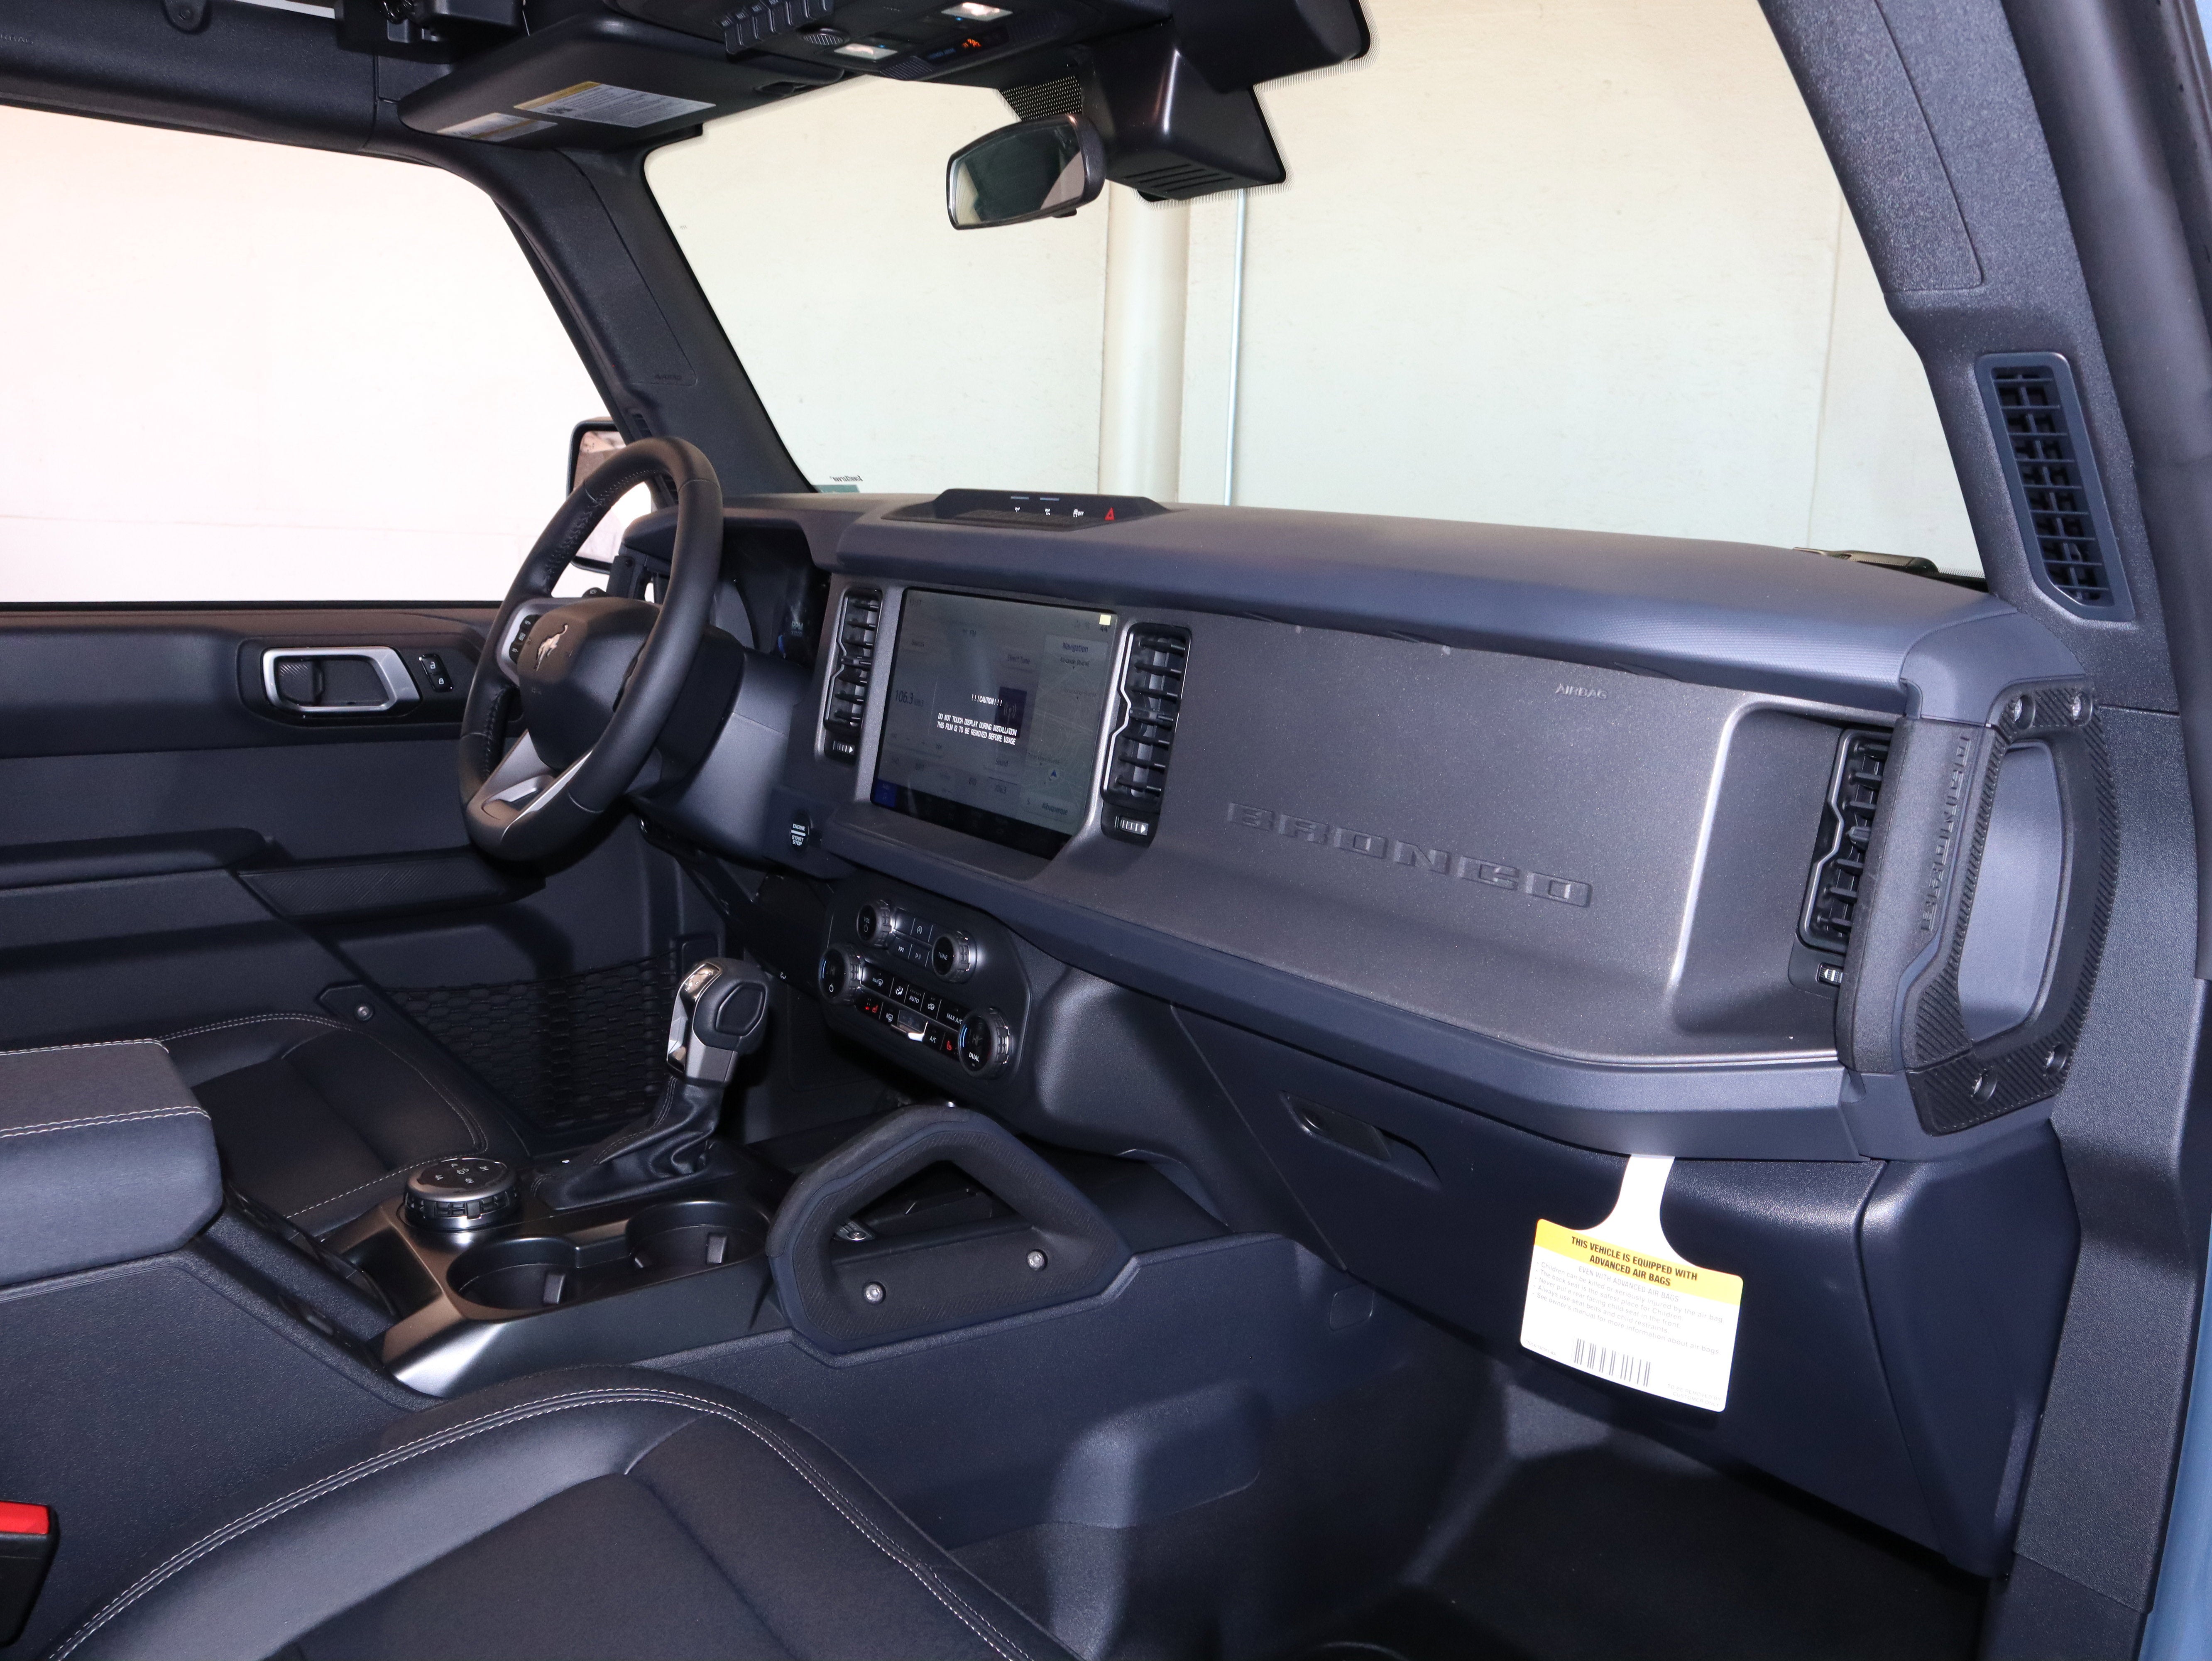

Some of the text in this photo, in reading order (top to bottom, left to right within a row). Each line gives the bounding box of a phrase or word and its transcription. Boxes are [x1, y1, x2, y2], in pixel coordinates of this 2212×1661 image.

[1063, 642, 1088, 653] Navigation
[896, 690, 913, 705] 106.3
[1555, 683, 1608, 699] AIRBAG
[952, 715, 964, 725] TOUCH
[964, 718, 979, 728] DISPLAY
[979, 721, 992, 731] DURING
[993, 725, 1017, 736] INSTALLATION
[971, 729, 987, 739] REMOVED
[988, 733, 1003, 742] BEFORE
[1003, 736, 1016, 745] USAGE
[1227, 802, 1593, 909] BRONCO
[938, 951, 948, 960] TUNE
[909, 995, 920, 1004] AUTO
[946, 1013, 956, 1022] MAX
[969, 1052, 980, 1062] DUAL
[1572, 1236, 1698, 1281] THIS VEHICLE IS EQUIPPED WITH
[1589, 1255, 1671, 1286] ADVANCED AIR BAGS
[1540, 1269, 1551, 1278] The
[1551, 1274, 1566, 1284] back
[1567, 1281, 1580, 1289] seat
[1588, 1287, 1598, 1296] the
[1599, 1292, 1619, 1303] safest
[1620, 1299, 1639, 1308] place
[1541, 1261, 1565, 1275] Children
[1588, 1279, 1605, 1289] killed
[1615, 1289, 1645, 1303] seriously
[1647, 1298, 1672, 1310] injured
[1673, 1305, 1682, 1313] by
[1578, 1265, 1679, 1303] EVEN WITH ADVANCED AIR BAGS
[1537, 1284, 1558, 1297] Always
[1571, 1298, 1585, 1307] seat
[1586, 1303, 1601, 1313] belts
[1617, 1314, 1633, 1323] child
[1539, 1276, 1556, 1288] Never
[1586, 1294, 1606, 1308] facing
[1607, 1303, 1624, 1312] child
[1625, 1308, 1639, 1317] seat
[1537, 1292, 1548, 1301] See
[1573, 1307, 1595, 1319] manual
[1608, 1319, 1625, 1329] more
[1626, 1325, 1666, 1341] information
[1667, 1338, 1688, 1347] about
[1673, 1392, 1703, 1402] CUSTOMER
[1685, 1388, 1712, 1399] REMOVED
